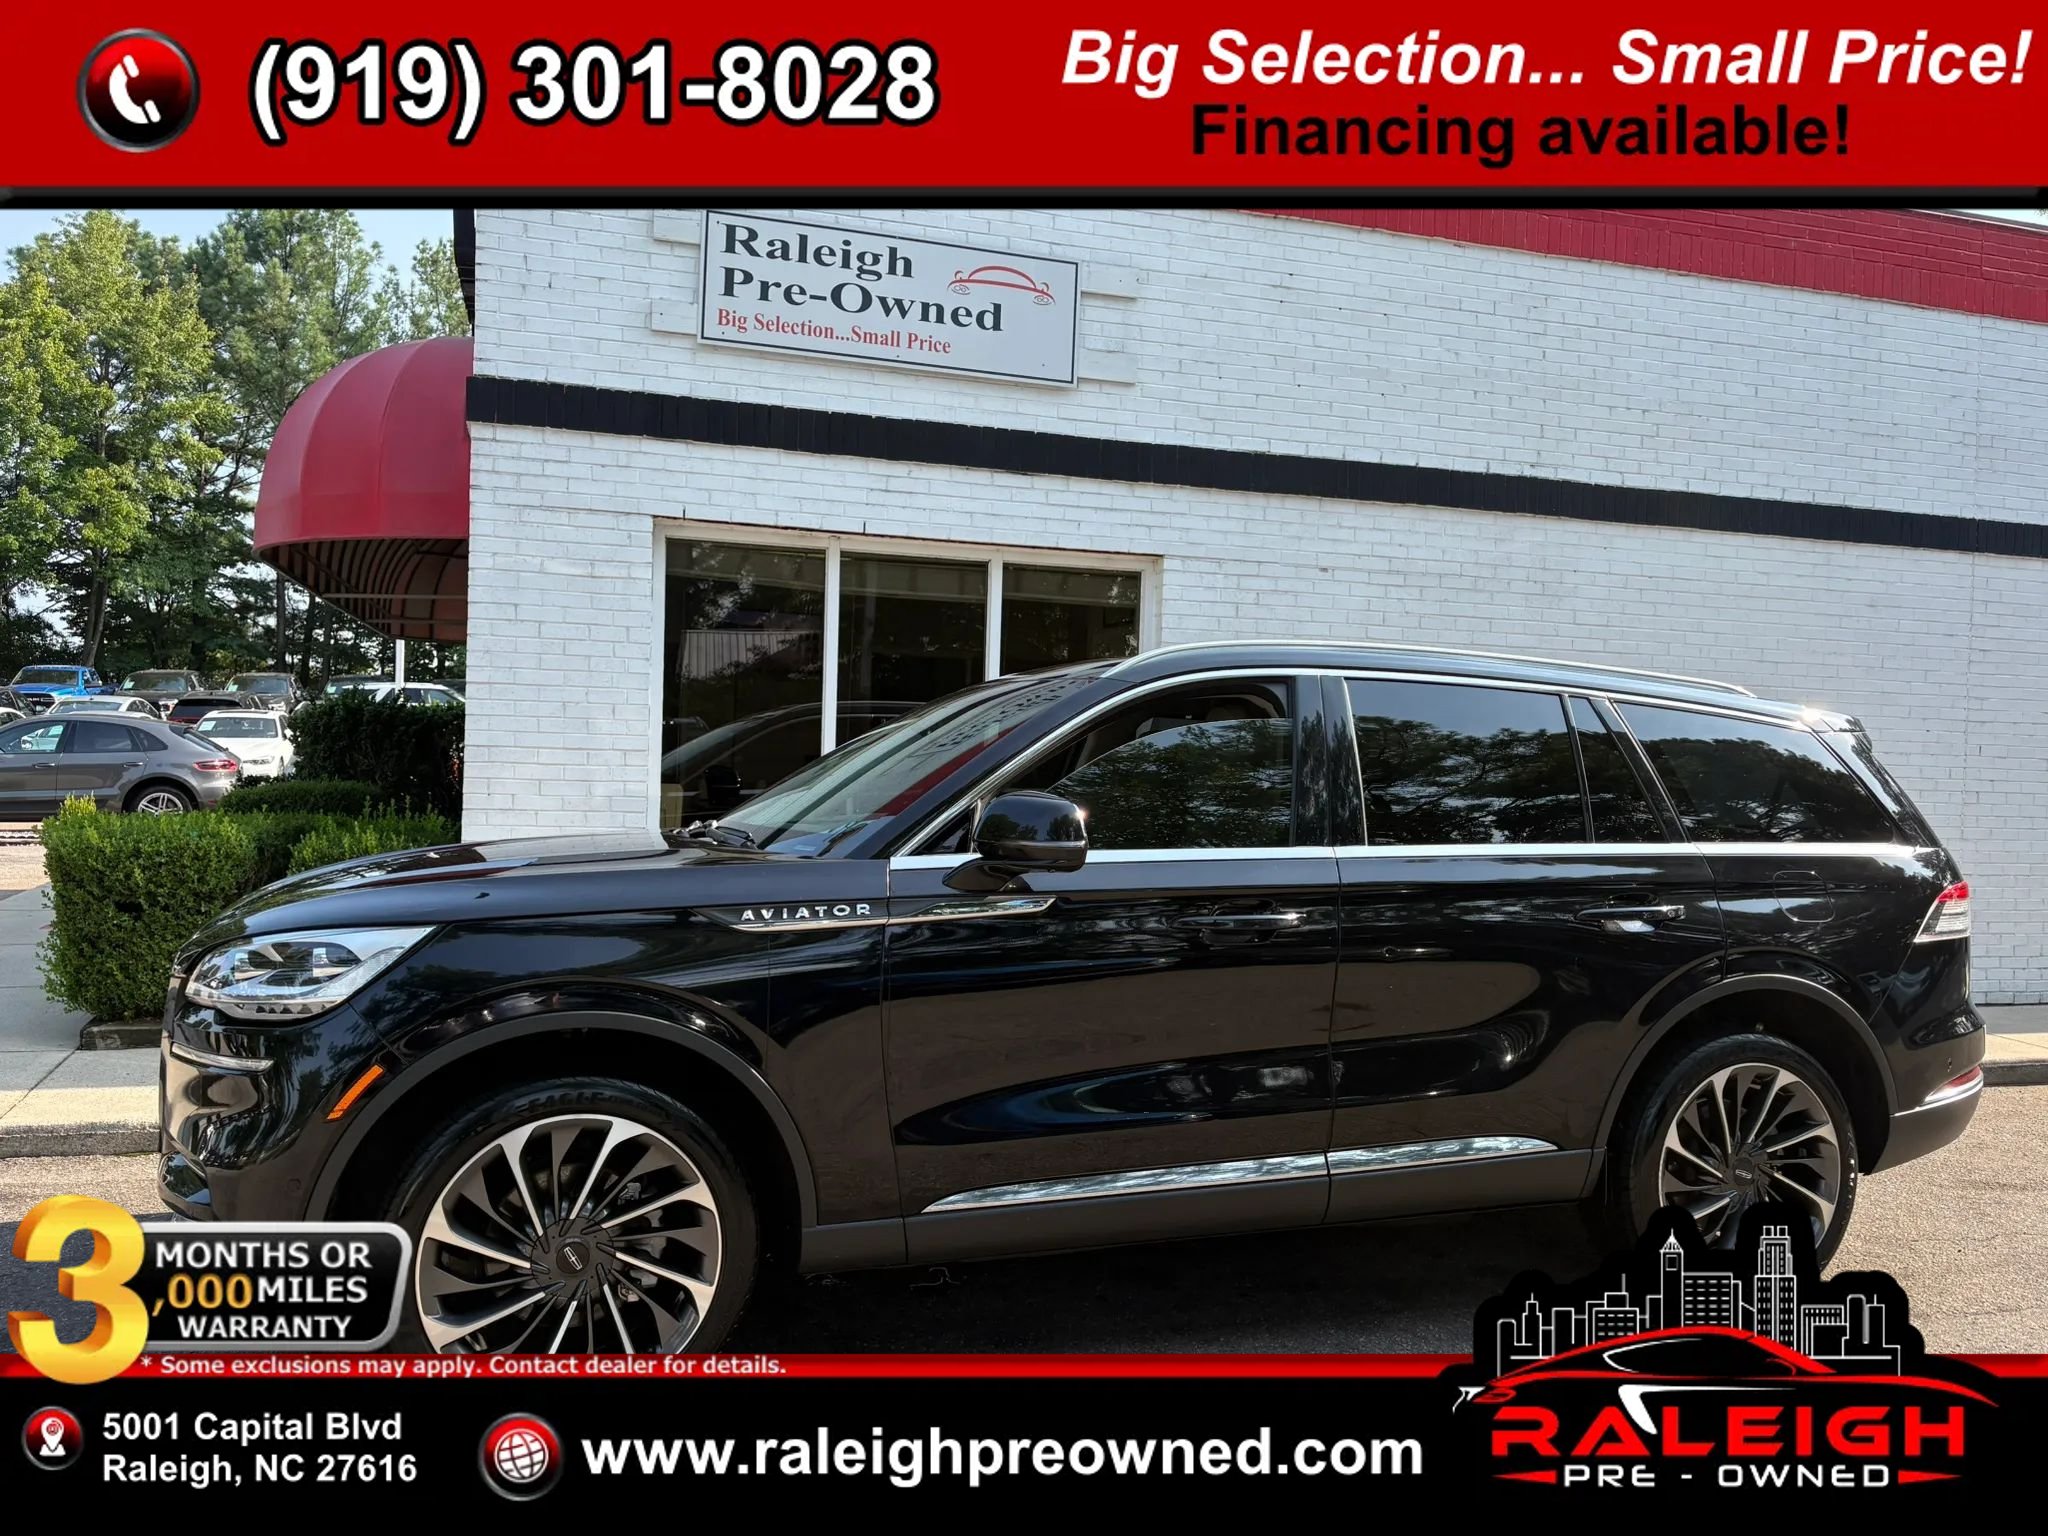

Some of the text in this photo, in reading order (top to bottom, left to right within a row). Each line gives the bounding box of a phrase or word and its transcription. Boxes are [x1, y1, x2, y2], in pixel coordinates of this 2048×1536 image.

[720, 223, 914, 281] Raleigh
[718, 265, 1004, 332] Pre-Owned
[718, 308, 748, 333] Big
[906, 332, 951, 354] Price
[740, 903, 872, 921] AVIATOR
